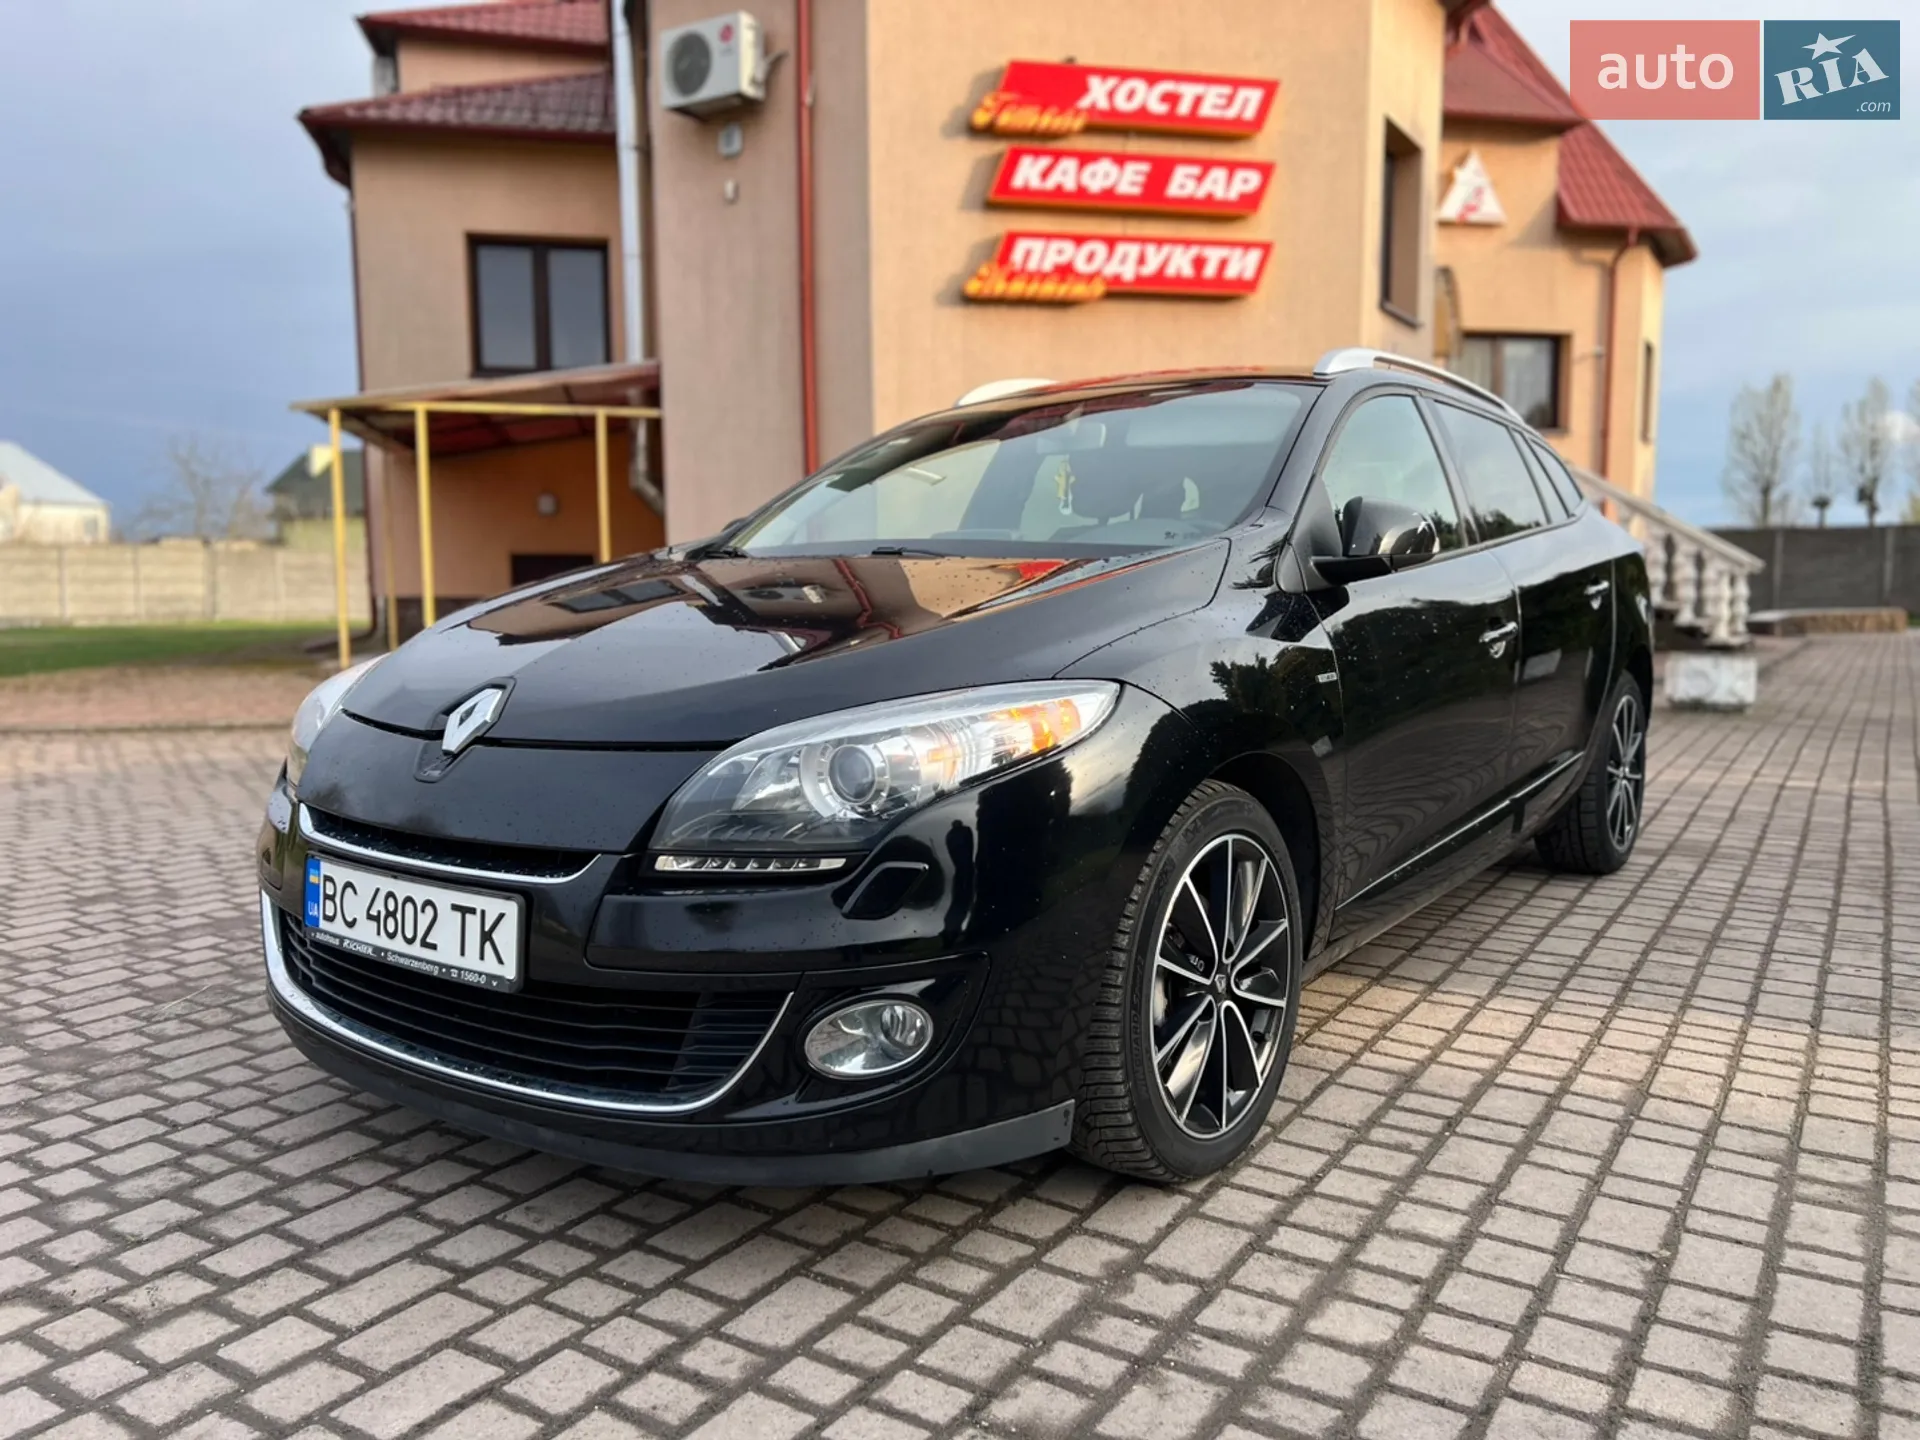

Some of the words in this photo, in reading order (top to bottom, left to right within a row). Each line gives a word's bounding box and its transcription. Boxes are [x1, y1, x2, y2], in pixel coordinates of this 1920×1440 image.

[1077, 74, 1266, 122] ХОСТЕЛ
[1009, 153, 1152, 196] КАФЕ
[1163, 163, 1263, 202] БАР
[1008, 236, 1264, 283] ПРОДУКТИ
[307, 901, 319, 917] UA
[322, 874, 358, 929] BC
[365, 887, 439, 951] 4802
[450, 902, 507, 966] TK
[386, 951, 439, 976] Schwarzenberg
